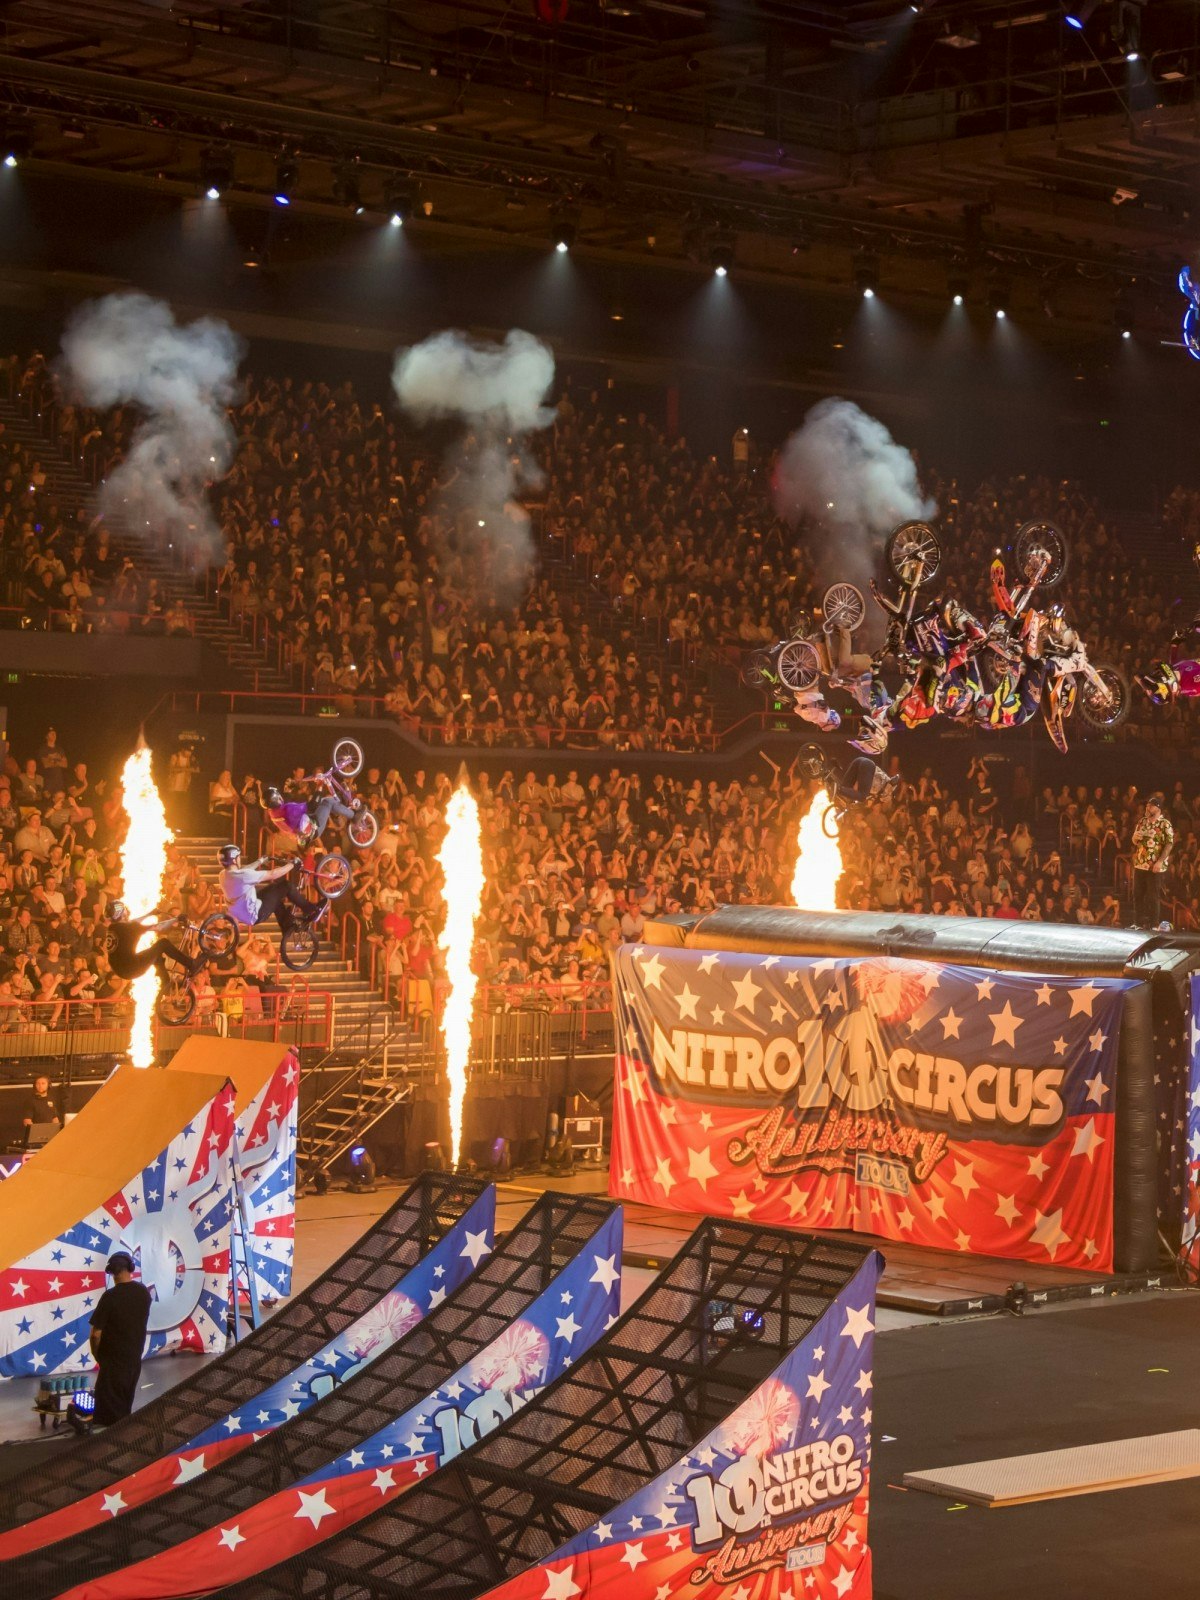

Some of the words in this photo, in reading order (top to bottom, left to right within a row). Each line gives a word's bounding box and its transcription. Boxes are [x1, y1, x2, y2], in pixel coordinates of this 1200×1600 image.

[653, 1020, 802, 1091] NITRO
[888, 1047, 1066, 1126] CIRCUS
[727, 1105, 949, 1180] Anniversary
[858, 1157, 909, 1191] TOUR
[762, 1434, 855, 1489] NITRO
[764, 1459, 863, 1516] CIRCUS
[690, 1501, 855, 1583] Anniversary
[788, 1545, 825, 1567] TOUR
